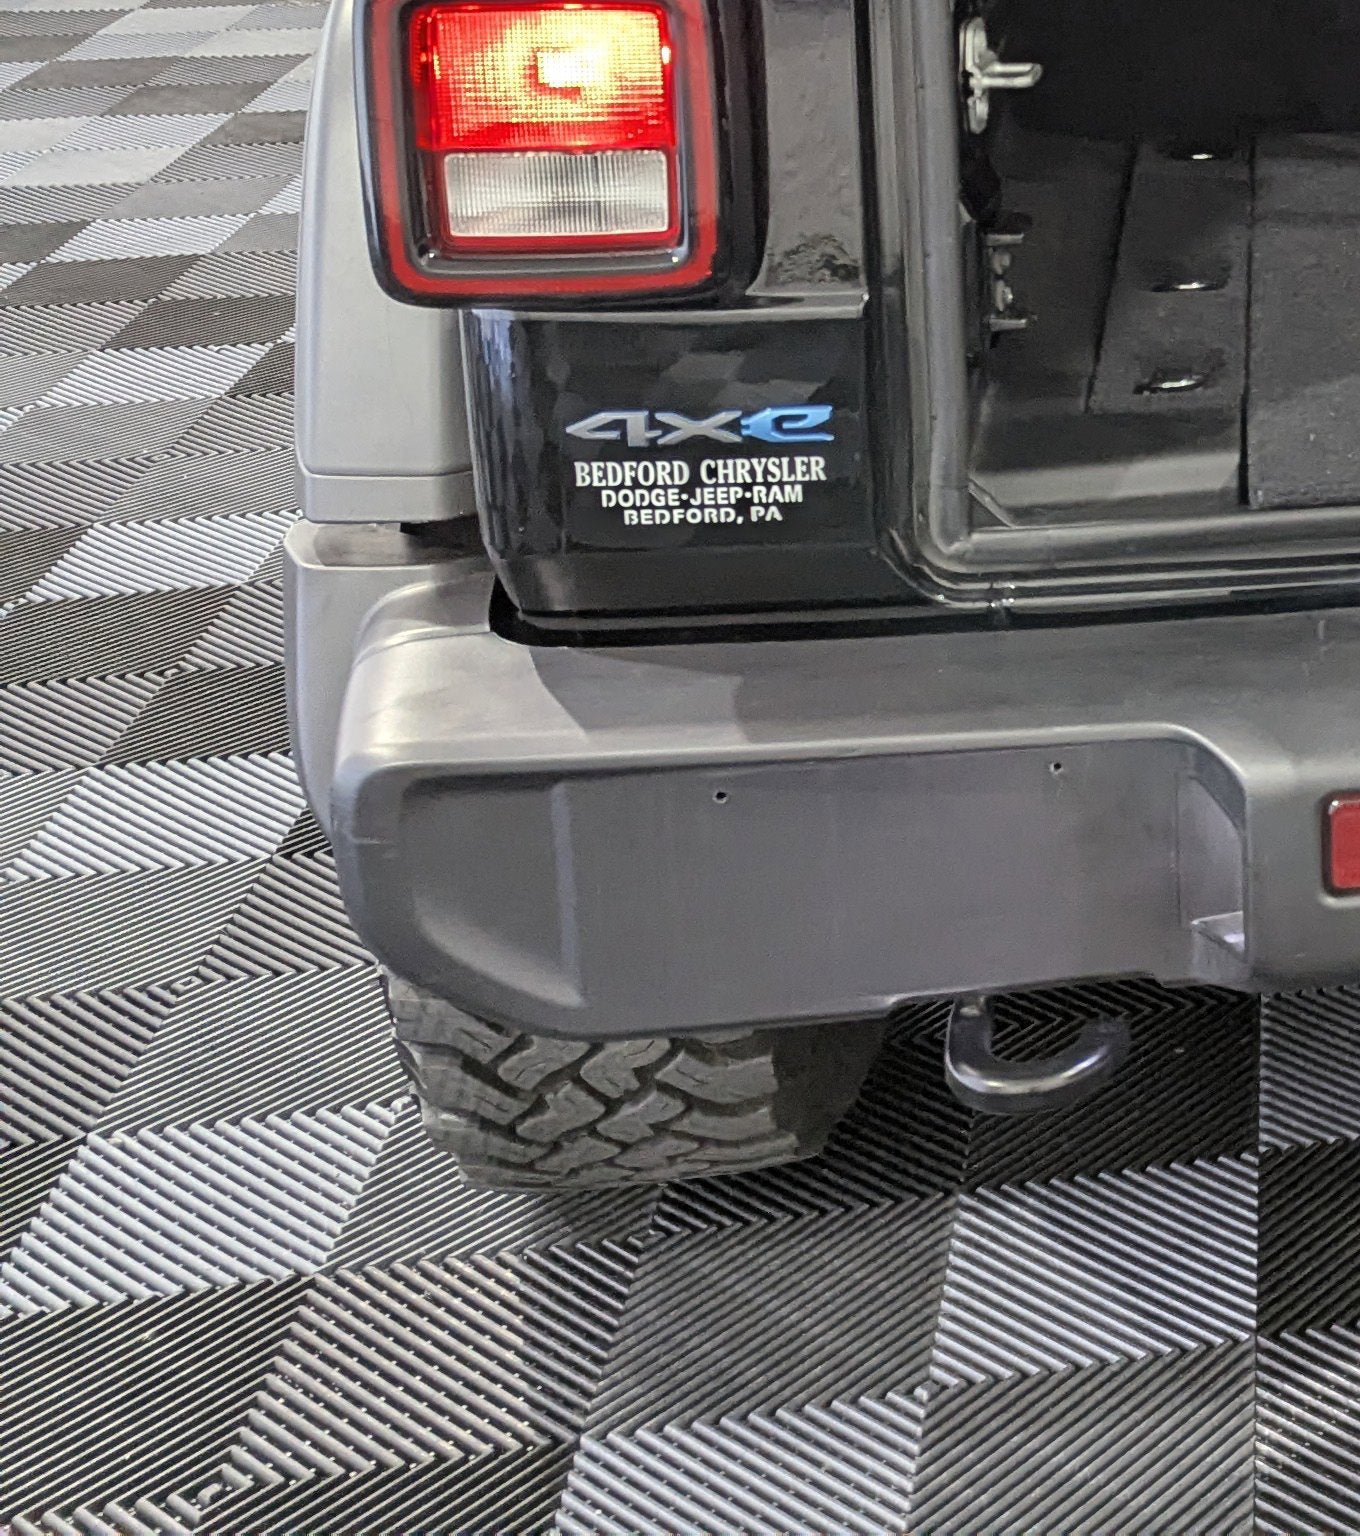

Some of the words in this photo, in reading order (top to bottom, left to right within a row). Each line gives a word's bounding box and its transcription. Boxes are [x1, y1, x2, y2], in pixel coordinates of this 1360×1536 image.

[574, 461, 690, 487] BEDFORD
[699, 456, 828, 486] CHRYSLER
[623, 508, 743, 526] BEDFORD,
[750, 506, 783, 522] PA
